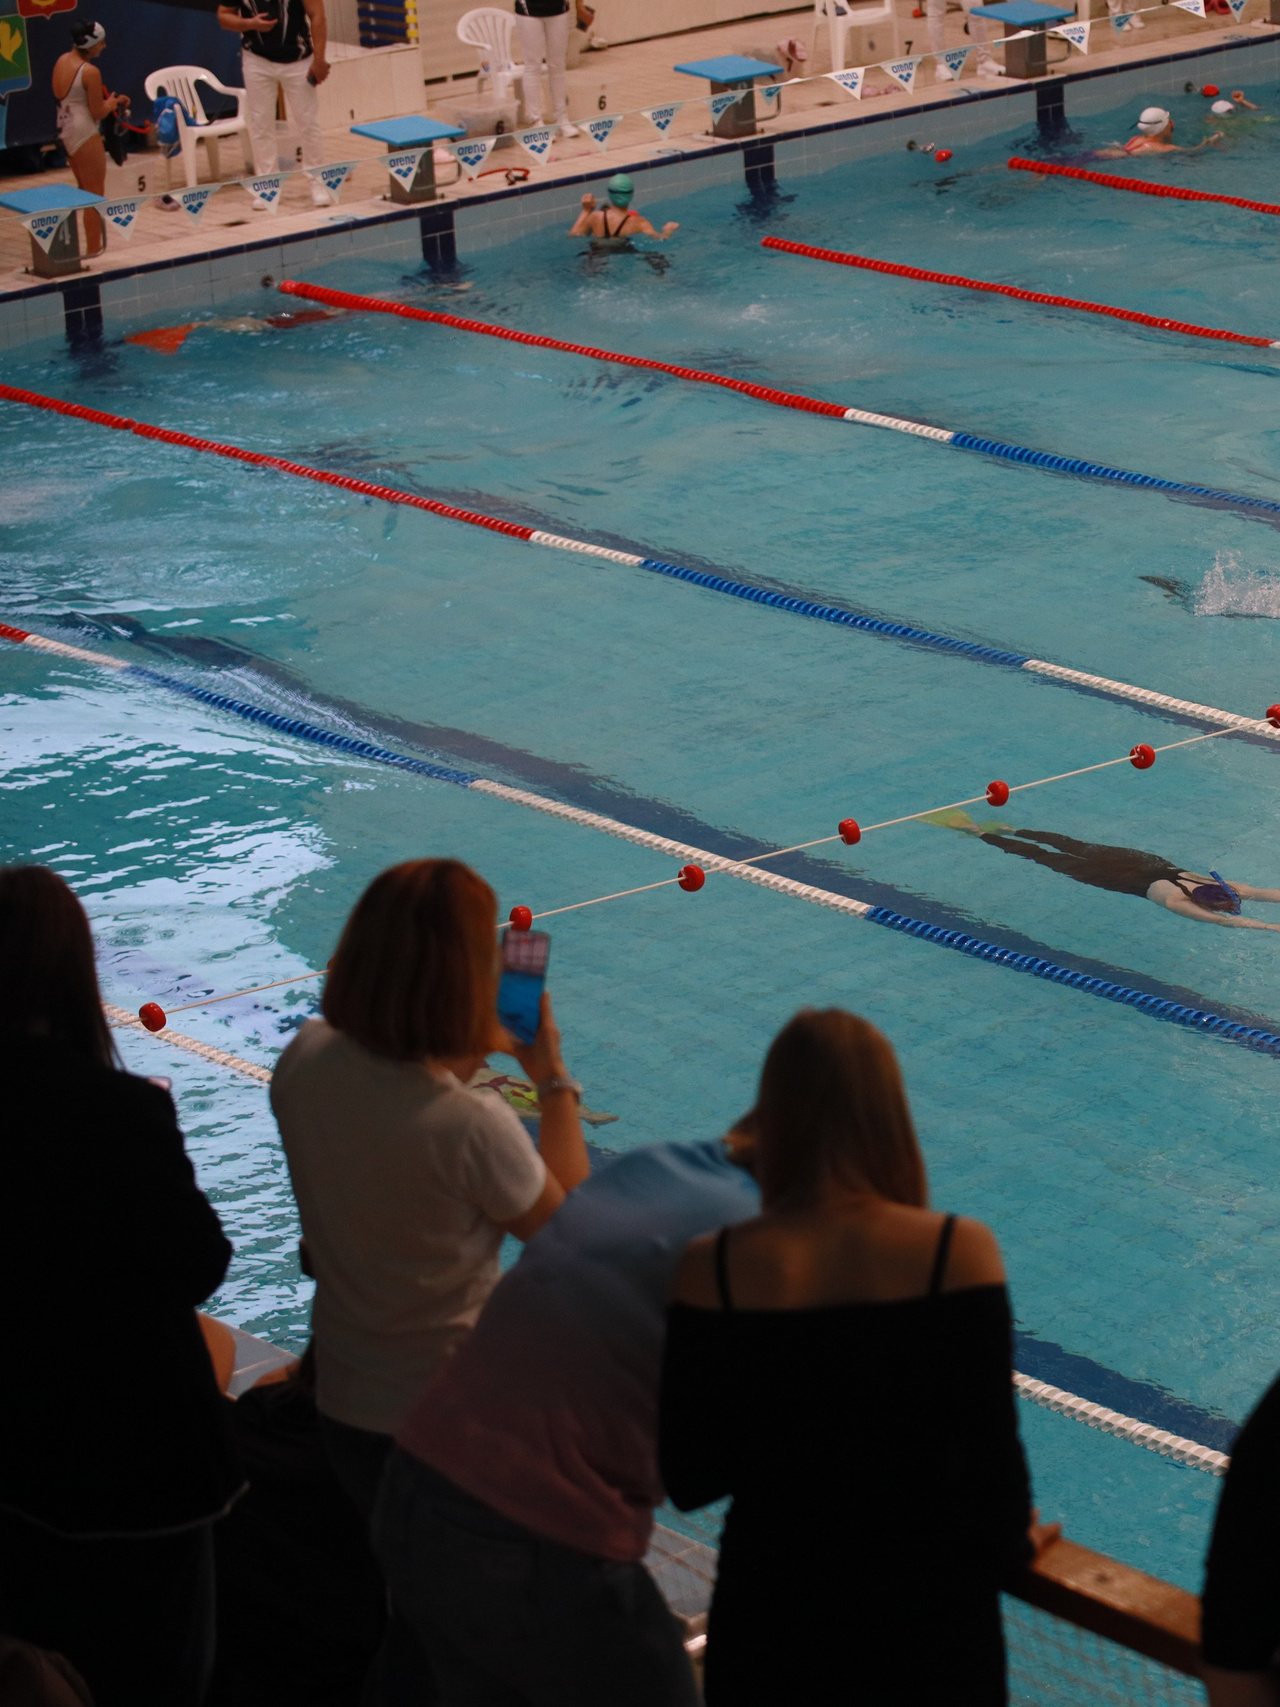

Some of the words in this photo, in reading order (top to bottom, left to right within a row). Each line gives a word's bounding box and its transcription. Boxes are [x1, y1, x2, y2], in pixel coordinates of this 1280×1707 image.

[905, 41, 913, 54] 7
[945, 49, 967, 63] arena
[891, 61, 914, 74] arena
[598, 95, 607, 110] 6
[651, 108, 675, 121] arena
[589, 119, 613, 133] arena
[523, 131, 550, 144] arena
[457, 143, 487, 156] arena
[389, 154, 416, 168] arena
[321, 166, 349, 181] arena
[138, 176, 146, 191] 5
[252, 178, 280, 192] arena
[182, 190, 209, 204] arena
[106, 202, 137, 217] arena
[31, 215, 59, 229] arena
